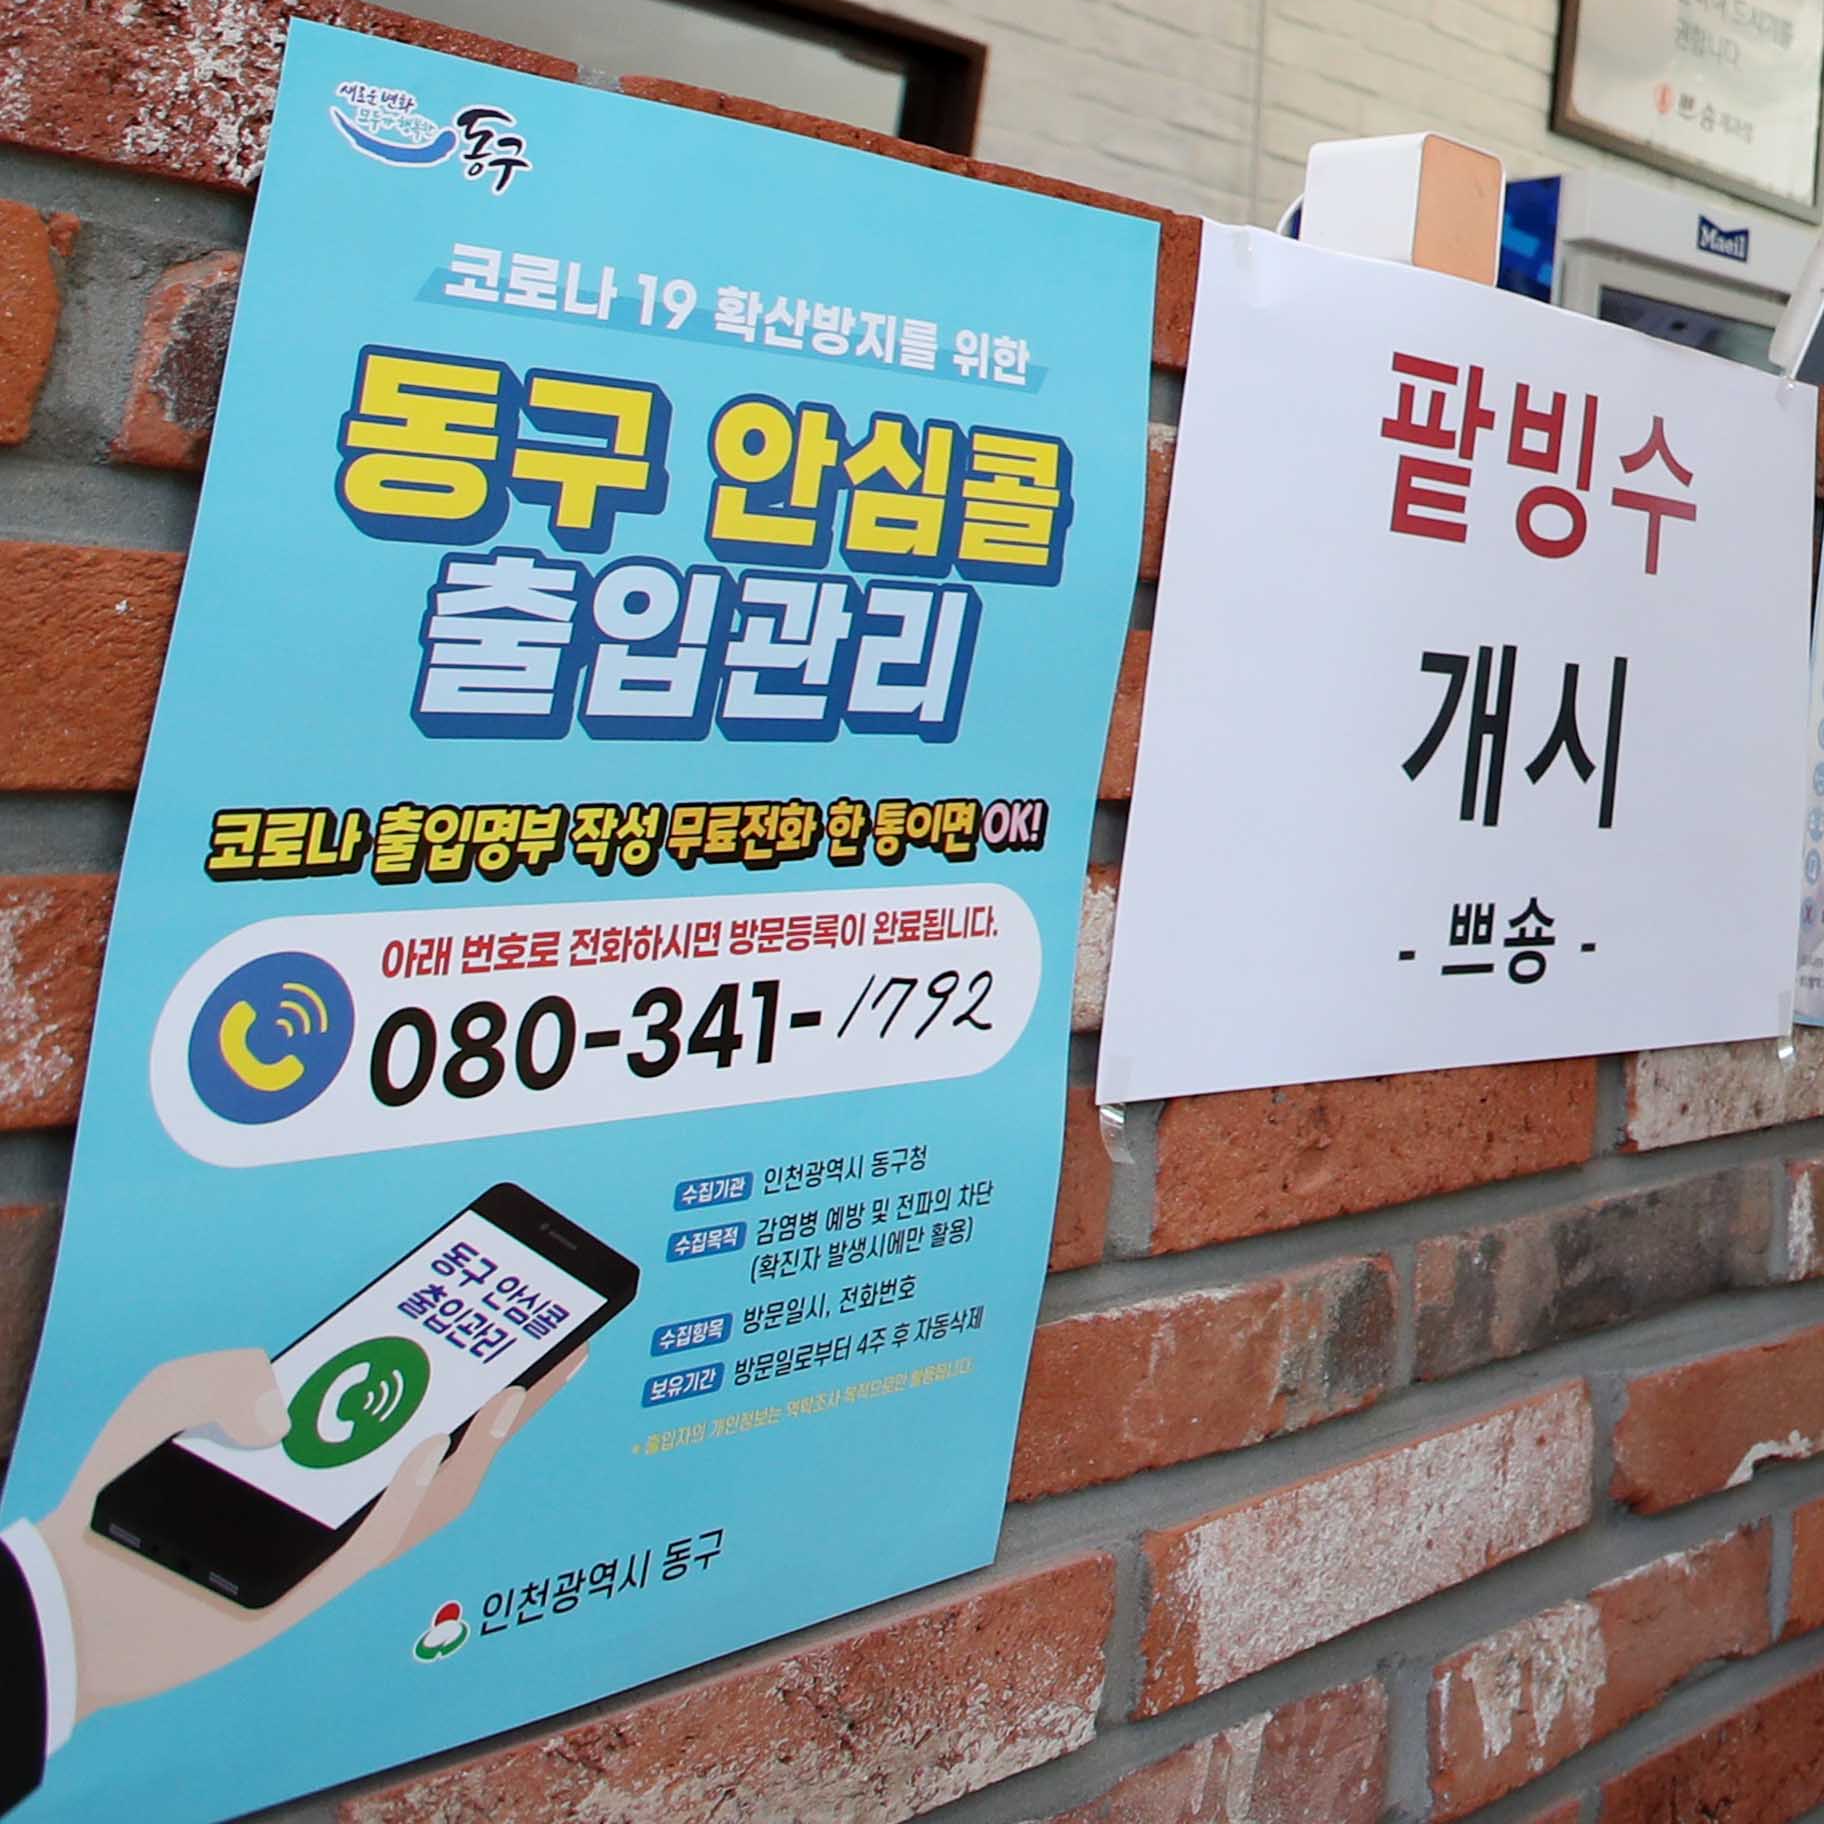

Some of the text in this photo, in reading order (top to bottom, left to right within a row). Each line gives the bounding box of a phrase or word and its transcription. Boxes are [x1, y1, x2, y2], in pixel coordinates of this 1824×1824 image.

[338, 83, 416, 111] 새로운 변화
[457, 108, 529, 191] 동구
[1700, 223, 1745, 259] Maeil
[444, 241, 1032, 386] 코로나 19 확산방지를 위한
[339, 350, 1069, 577] 동구 안심콜
[1381, 351, 1697, 576] 팥빙수
[421, 551, 979, 730] 출입관리
[1401, 644, 1628, 829] 개시
[206, 798, 1046, 881] 코로나 출입명부 작성 무료전화 한 통이면 OK!
[381, 905, 999, 978] 아래 번호로 전화하시면 방문등록이 완료됩니다.
[1441, 896, 1556, 985] 쁘숑
[681, 1144, 928, 1206] 수집기관 인천광역시 동구청
[673, 1179, 995, 1257] 수집목적 감염병 예방 및 전파의 차단
[750, 1215, 975, 1284] (확진자 발생시에만 활용)
[396, 1283, 519, 1364] 출입관리
[430, 1241, 571, 1340] 동구 안심콜
[659, 1274, 917, 1351] 수집항목 방문일시, 전화번호
[650, 1305, 985, 1402] 보유기간 방문일로부터 4주 후 자동삭제
[479, 1528, 725, 1638] 인천광역시 동구
